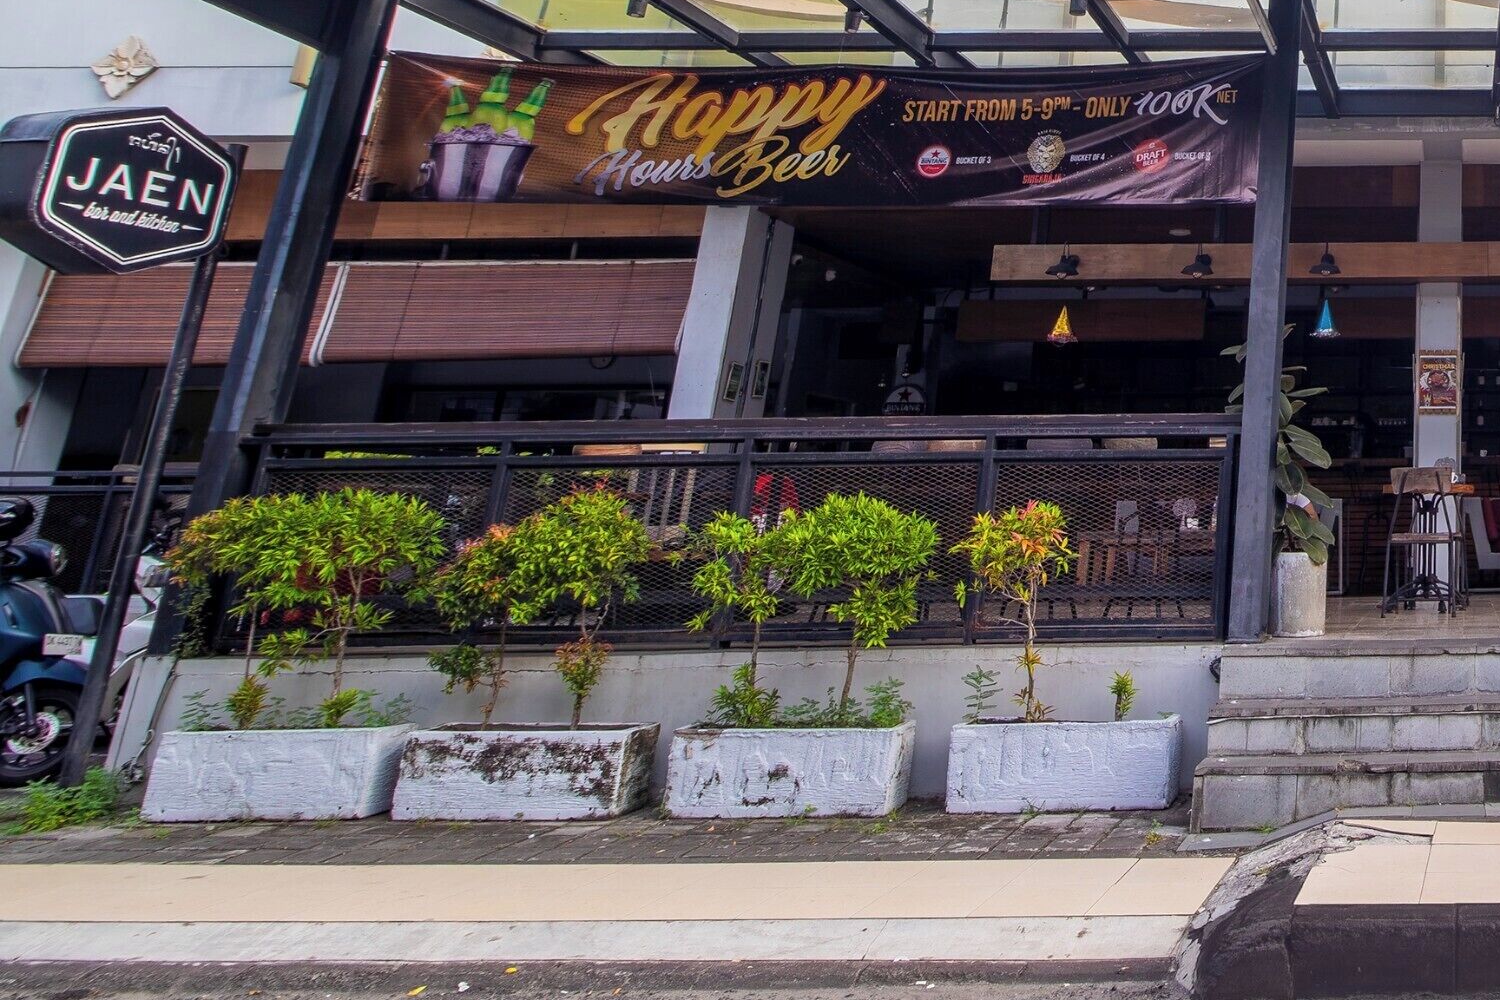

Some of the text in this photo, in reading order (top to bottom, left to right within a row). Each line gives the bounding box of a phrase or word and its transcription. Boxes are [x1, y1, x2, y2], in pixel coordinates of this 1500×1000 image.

[902, 99, 962, 122] START
[964, 98, 1017, 122] FROM
[1085, 96, 1132, 118] ONLY
[1133, 83, 1232, 126] 100K
[1216, 89, 1239, 104] NET
[565, 71, 887, 166] Happy
[920, 157, 948, 165] BINTANG
[955, 156, 992, 165] BUCKET OF 3
[1070, 154, 1092, 162] BUCKET
[1092, 153, 1101, 161] OF
[1136, 148, 1167, 162] DRAFT
[1174, 152, 1197, 160] BUCKET
[1197, 151, 1205, 159] OF
[573, 136, 852, 199] Hours Beer
[66, 157, 215, 216] JAEN
[83, 201, 180, 234] bar and kitchen
